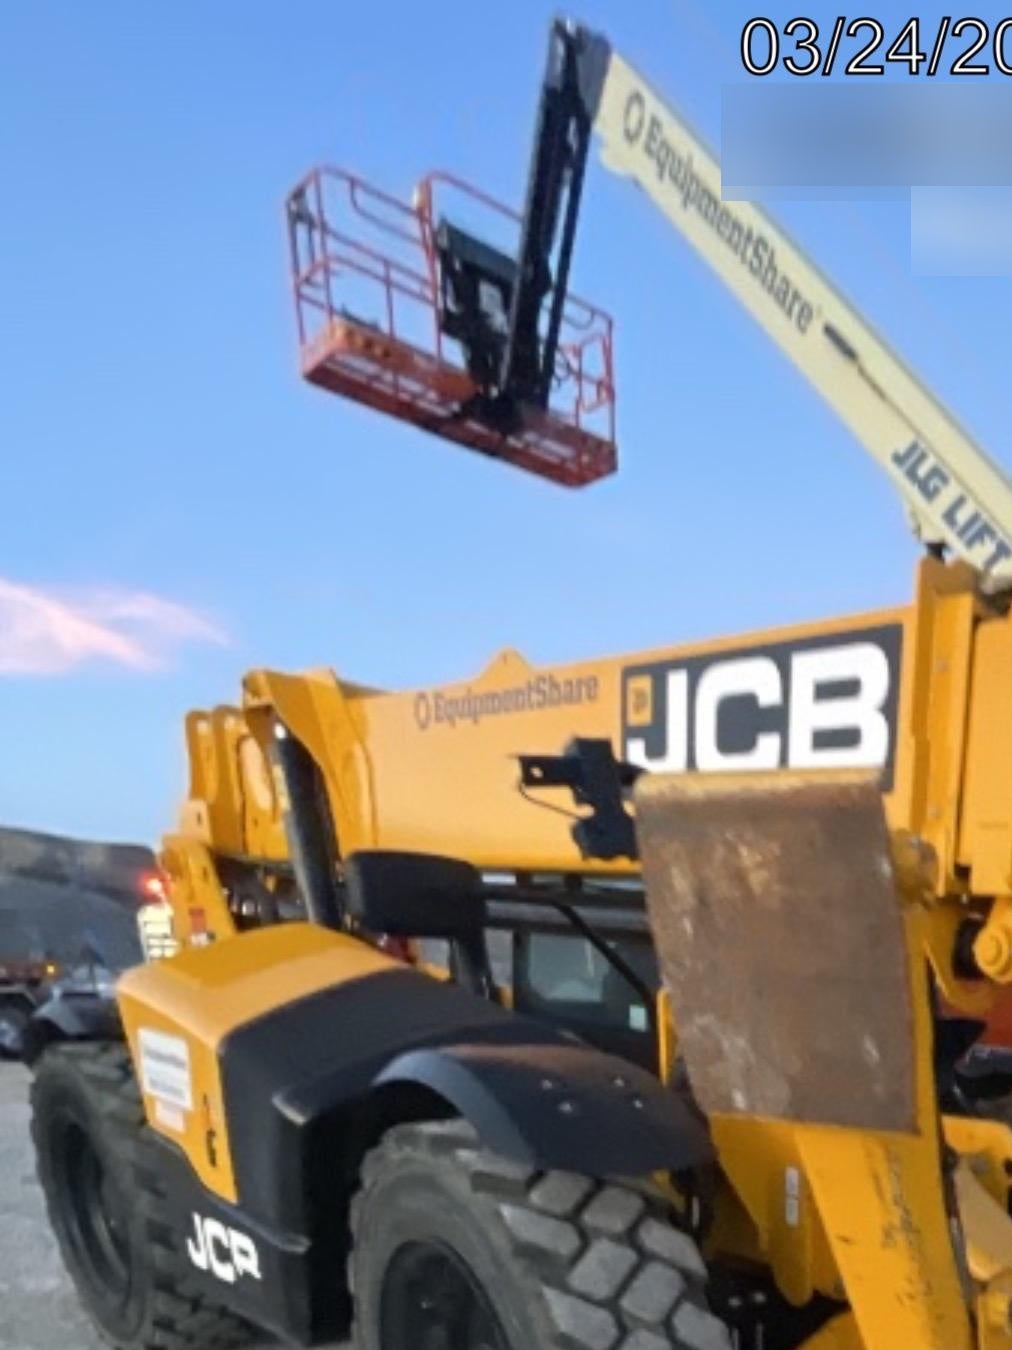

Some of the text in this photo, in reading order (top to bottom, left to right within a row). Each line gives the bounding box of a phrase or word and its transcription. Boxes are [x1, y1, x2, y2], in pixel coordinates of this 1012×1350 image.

[645, 112, 814, 335] EquipmentShare
[891, 440, 950, 502] JLG
[434, 674, 598, 728] EquipmentShare
[626, 641, 889, 773] JCB
